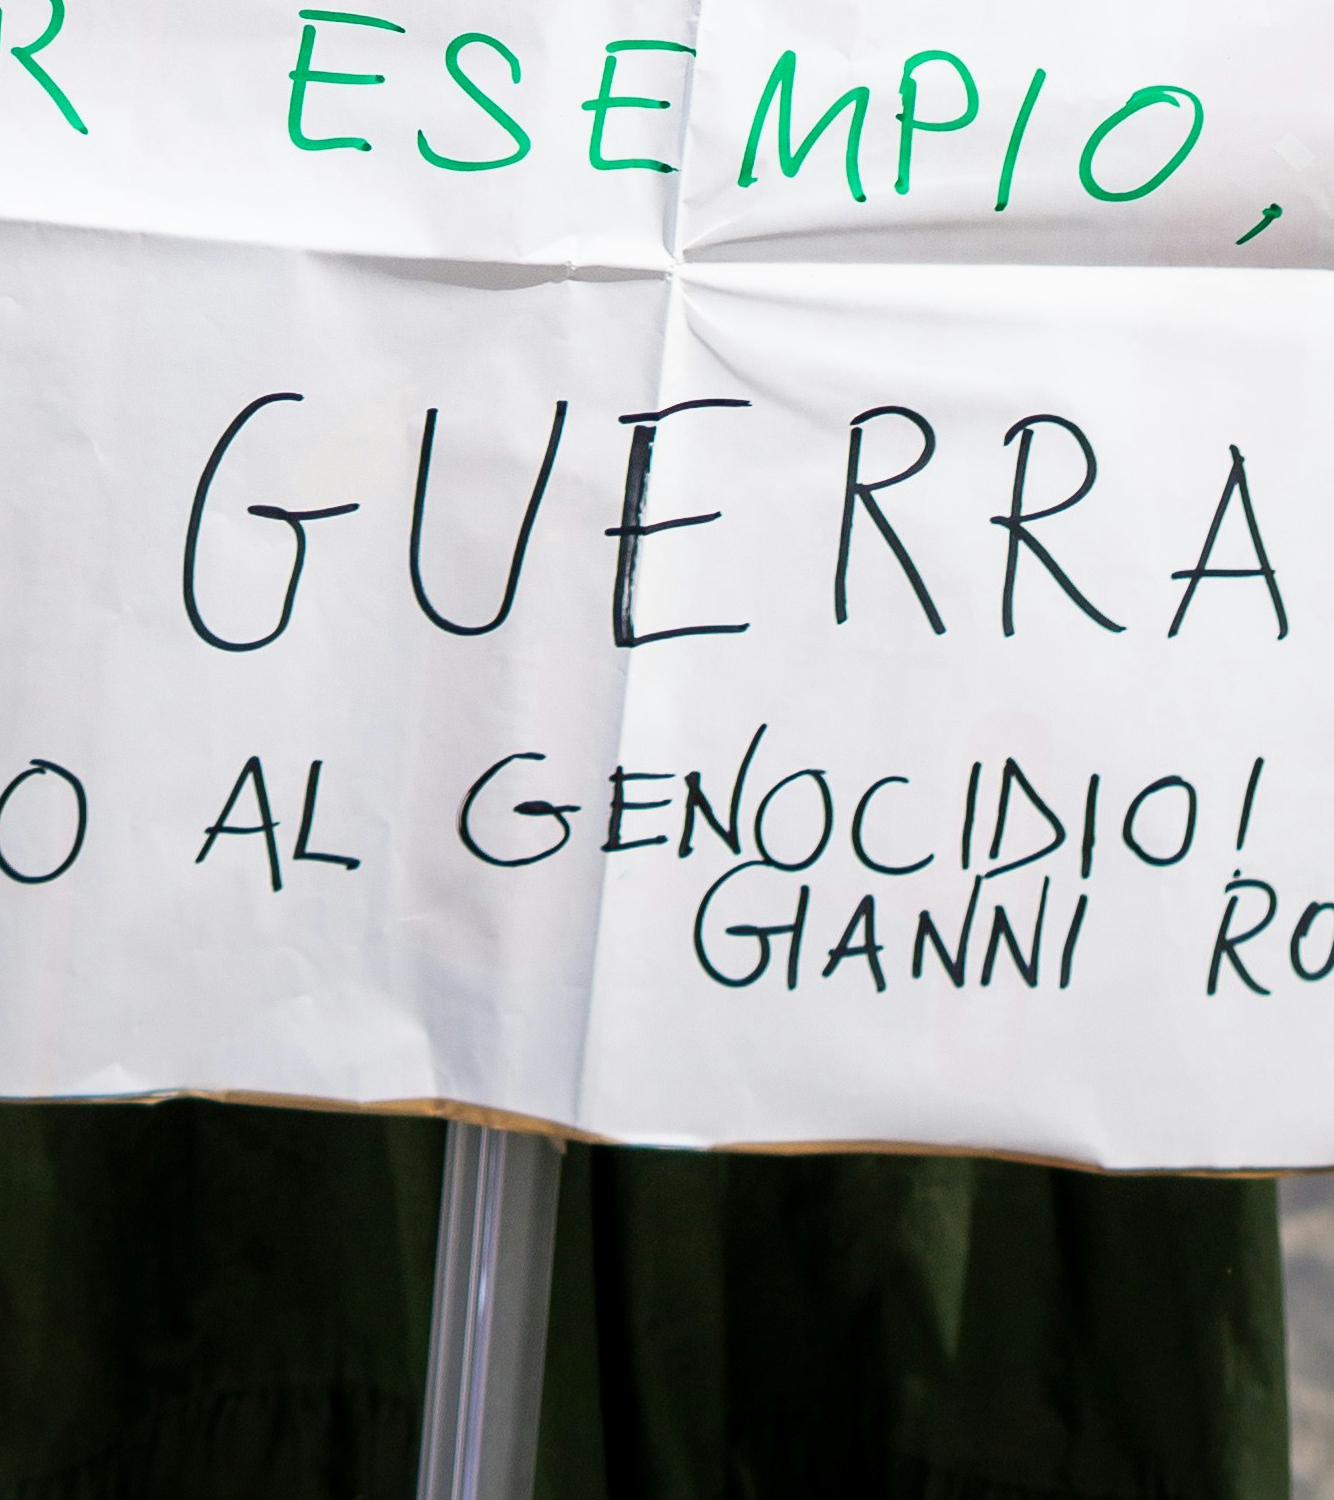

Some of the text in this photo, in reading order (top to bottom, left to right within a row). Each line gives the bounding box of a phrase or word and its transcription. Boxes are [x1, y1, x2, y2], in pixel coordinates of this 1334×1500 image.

[288, 10, 1283, 246] ESEMPIO,
[196, 757, 361, 892] AL
[459, 724, 1265, 880] GENOCIDIO!
[694, 860, 1088, 990] GIANNI
